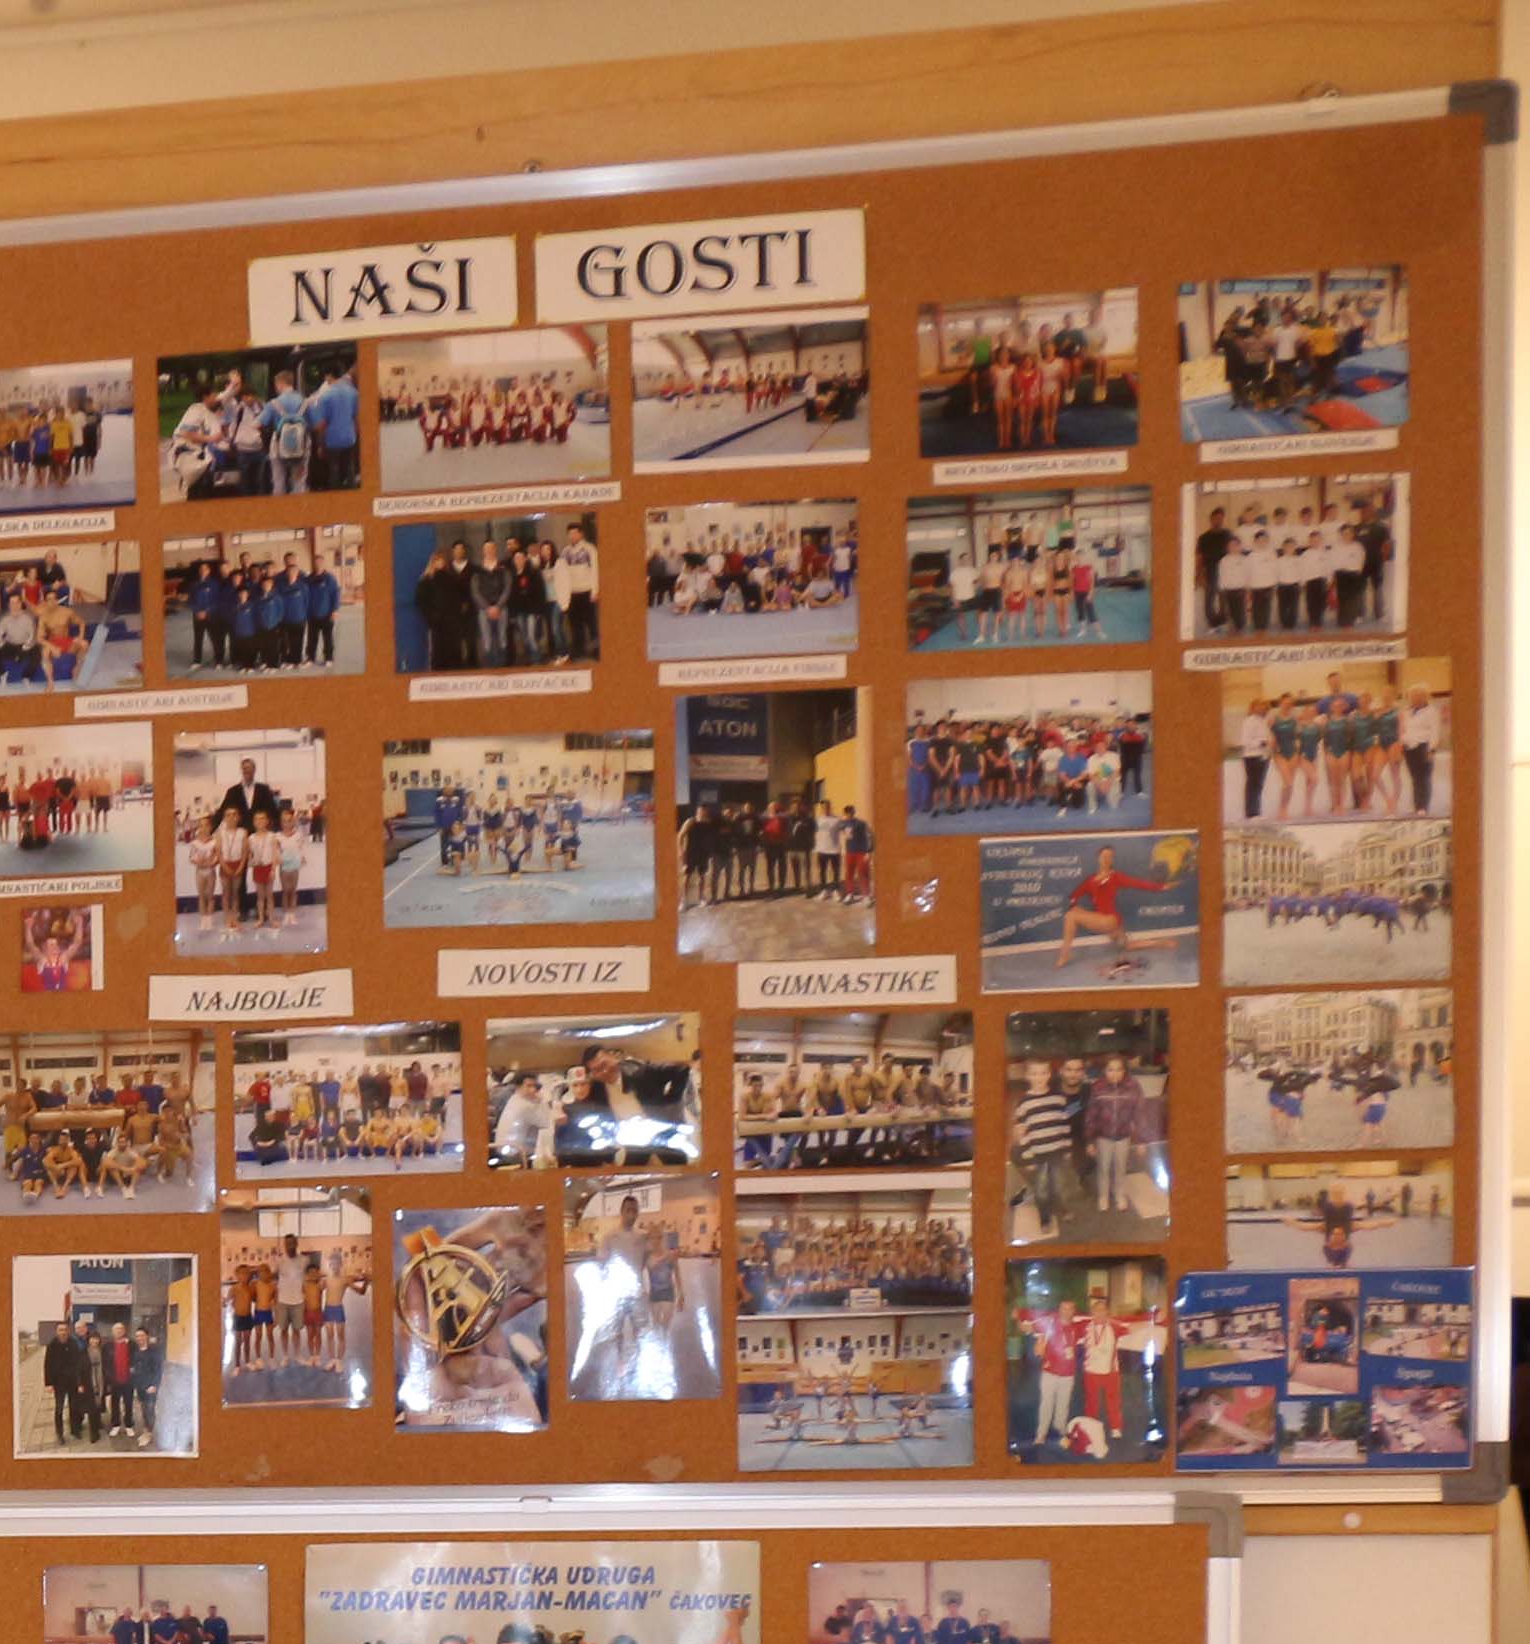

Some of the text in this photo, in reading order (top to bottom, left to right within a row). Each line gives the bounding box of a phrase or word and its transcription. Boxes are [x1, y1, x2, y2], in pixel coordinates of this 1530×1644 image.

[577, 228, 817, 300] GOSTI
[290, 243, 477, 325] NAŠI
[697, 719, 758, 738] ATON
[467, 960, 623, 986] NOVOSTI IZ
[761, 970, 940, 997] GIMNASTIKE
[186, 987, 327, 1011] NAJBOLJE
[412, 1562, 656, 1586] GIMNASTIČKA UDRUGA
[669, 1590, 753, 1611] ČAKOVEC
